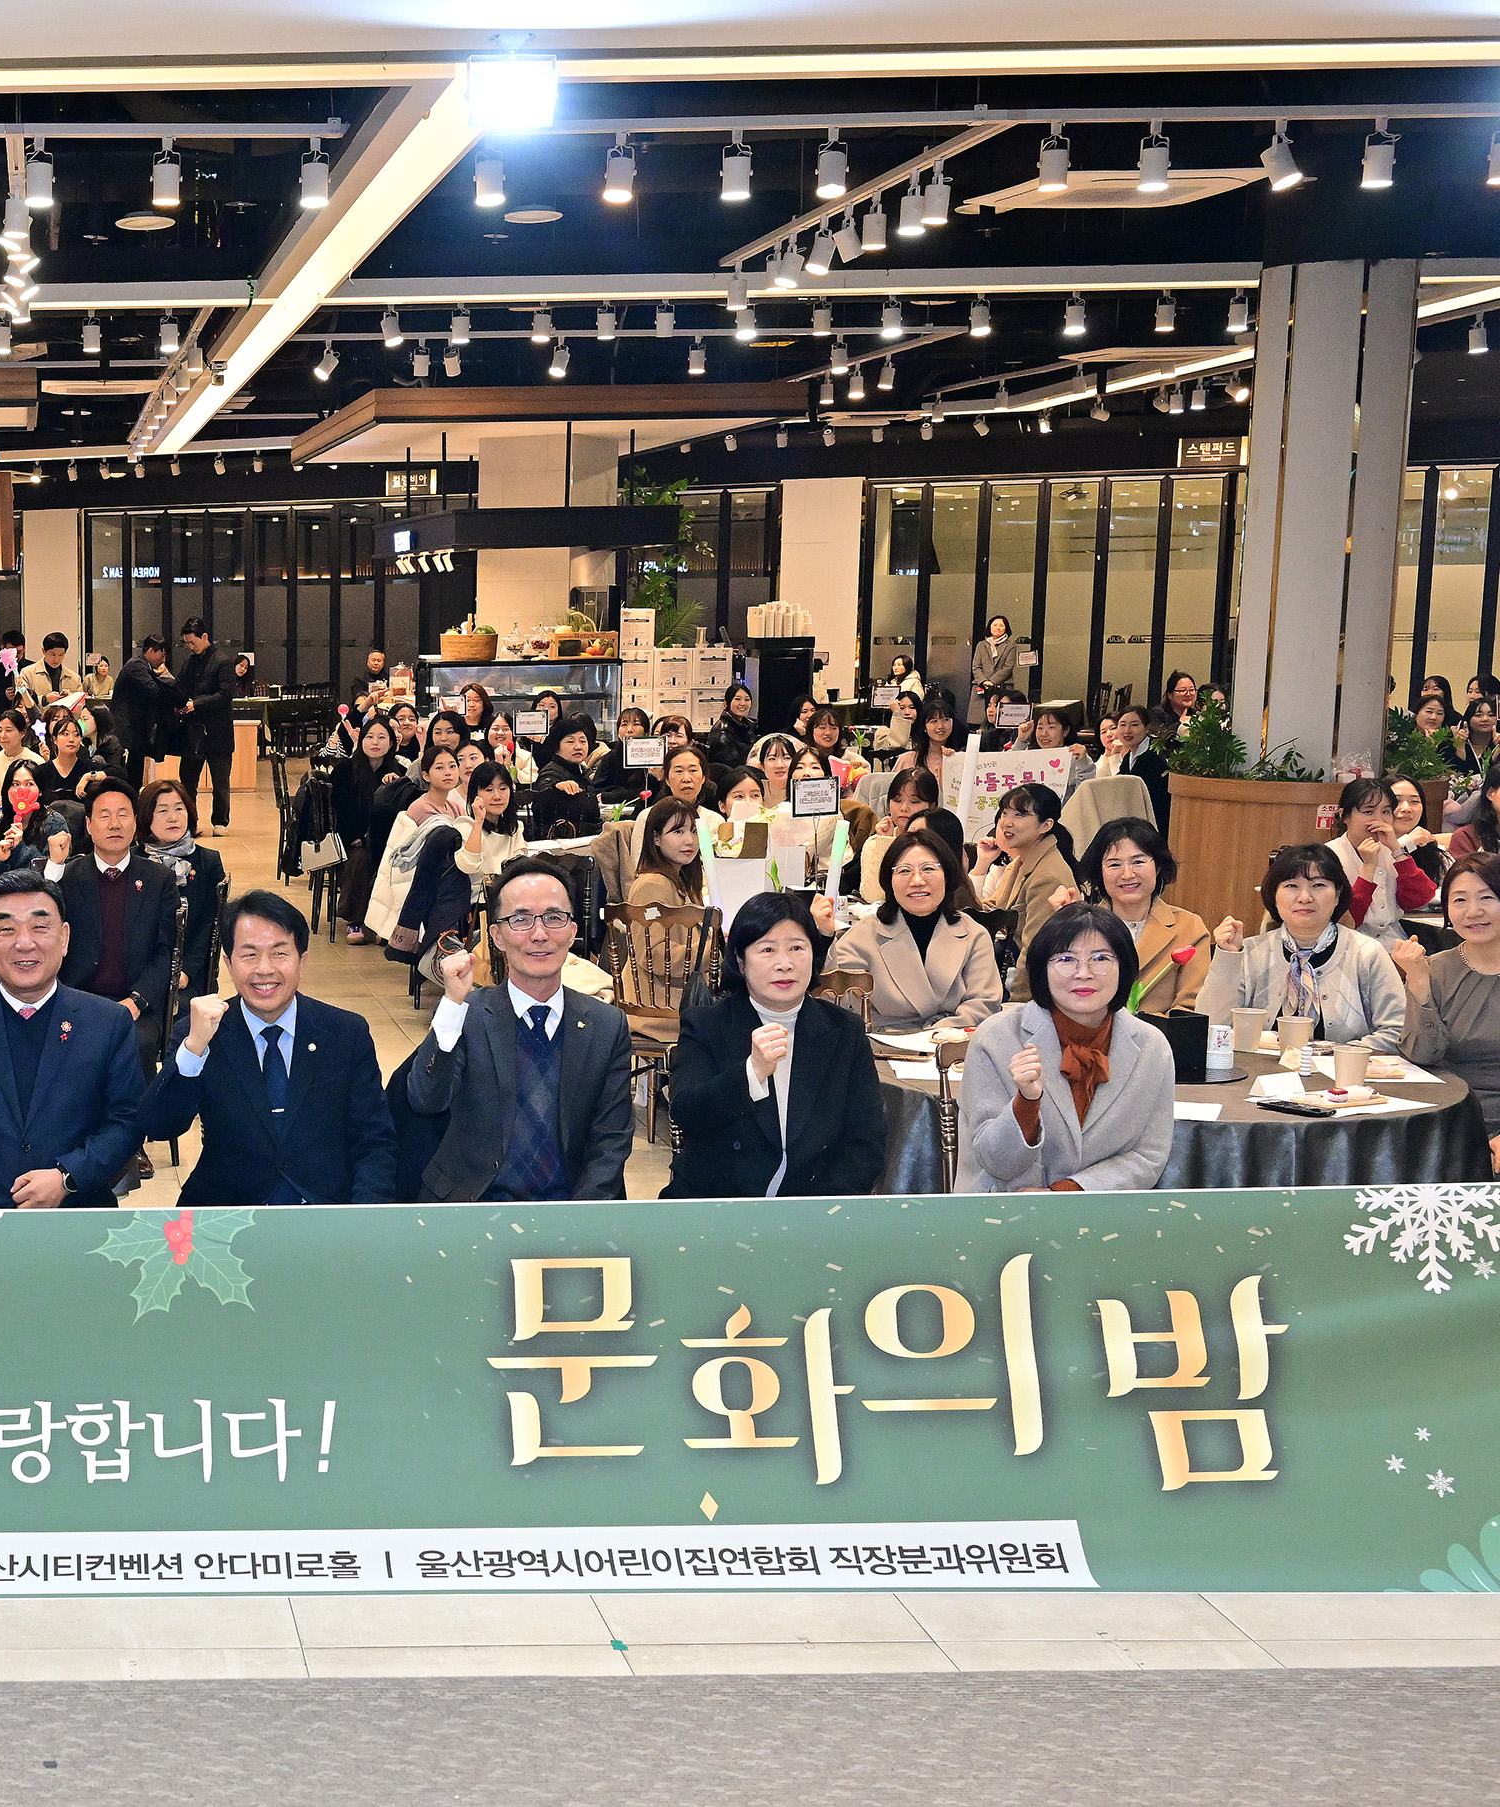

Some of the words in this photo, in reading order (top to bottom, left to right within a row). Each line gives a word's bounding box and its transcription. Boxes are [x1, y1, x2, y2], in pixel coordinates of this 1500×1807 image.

[1186, 442, 1236, 455] 스텐퍼드
[486, 1253, 1044, 1486] 문화의
[1095, 1275, 1289, 1492] 밤
[195, 1551, 361, 1579] 안다미로홀
[417, 1547, 820, 1577] 울산광역시어린이집연합회
[829, 1543, 1069, 1575] 직장분과위원회
